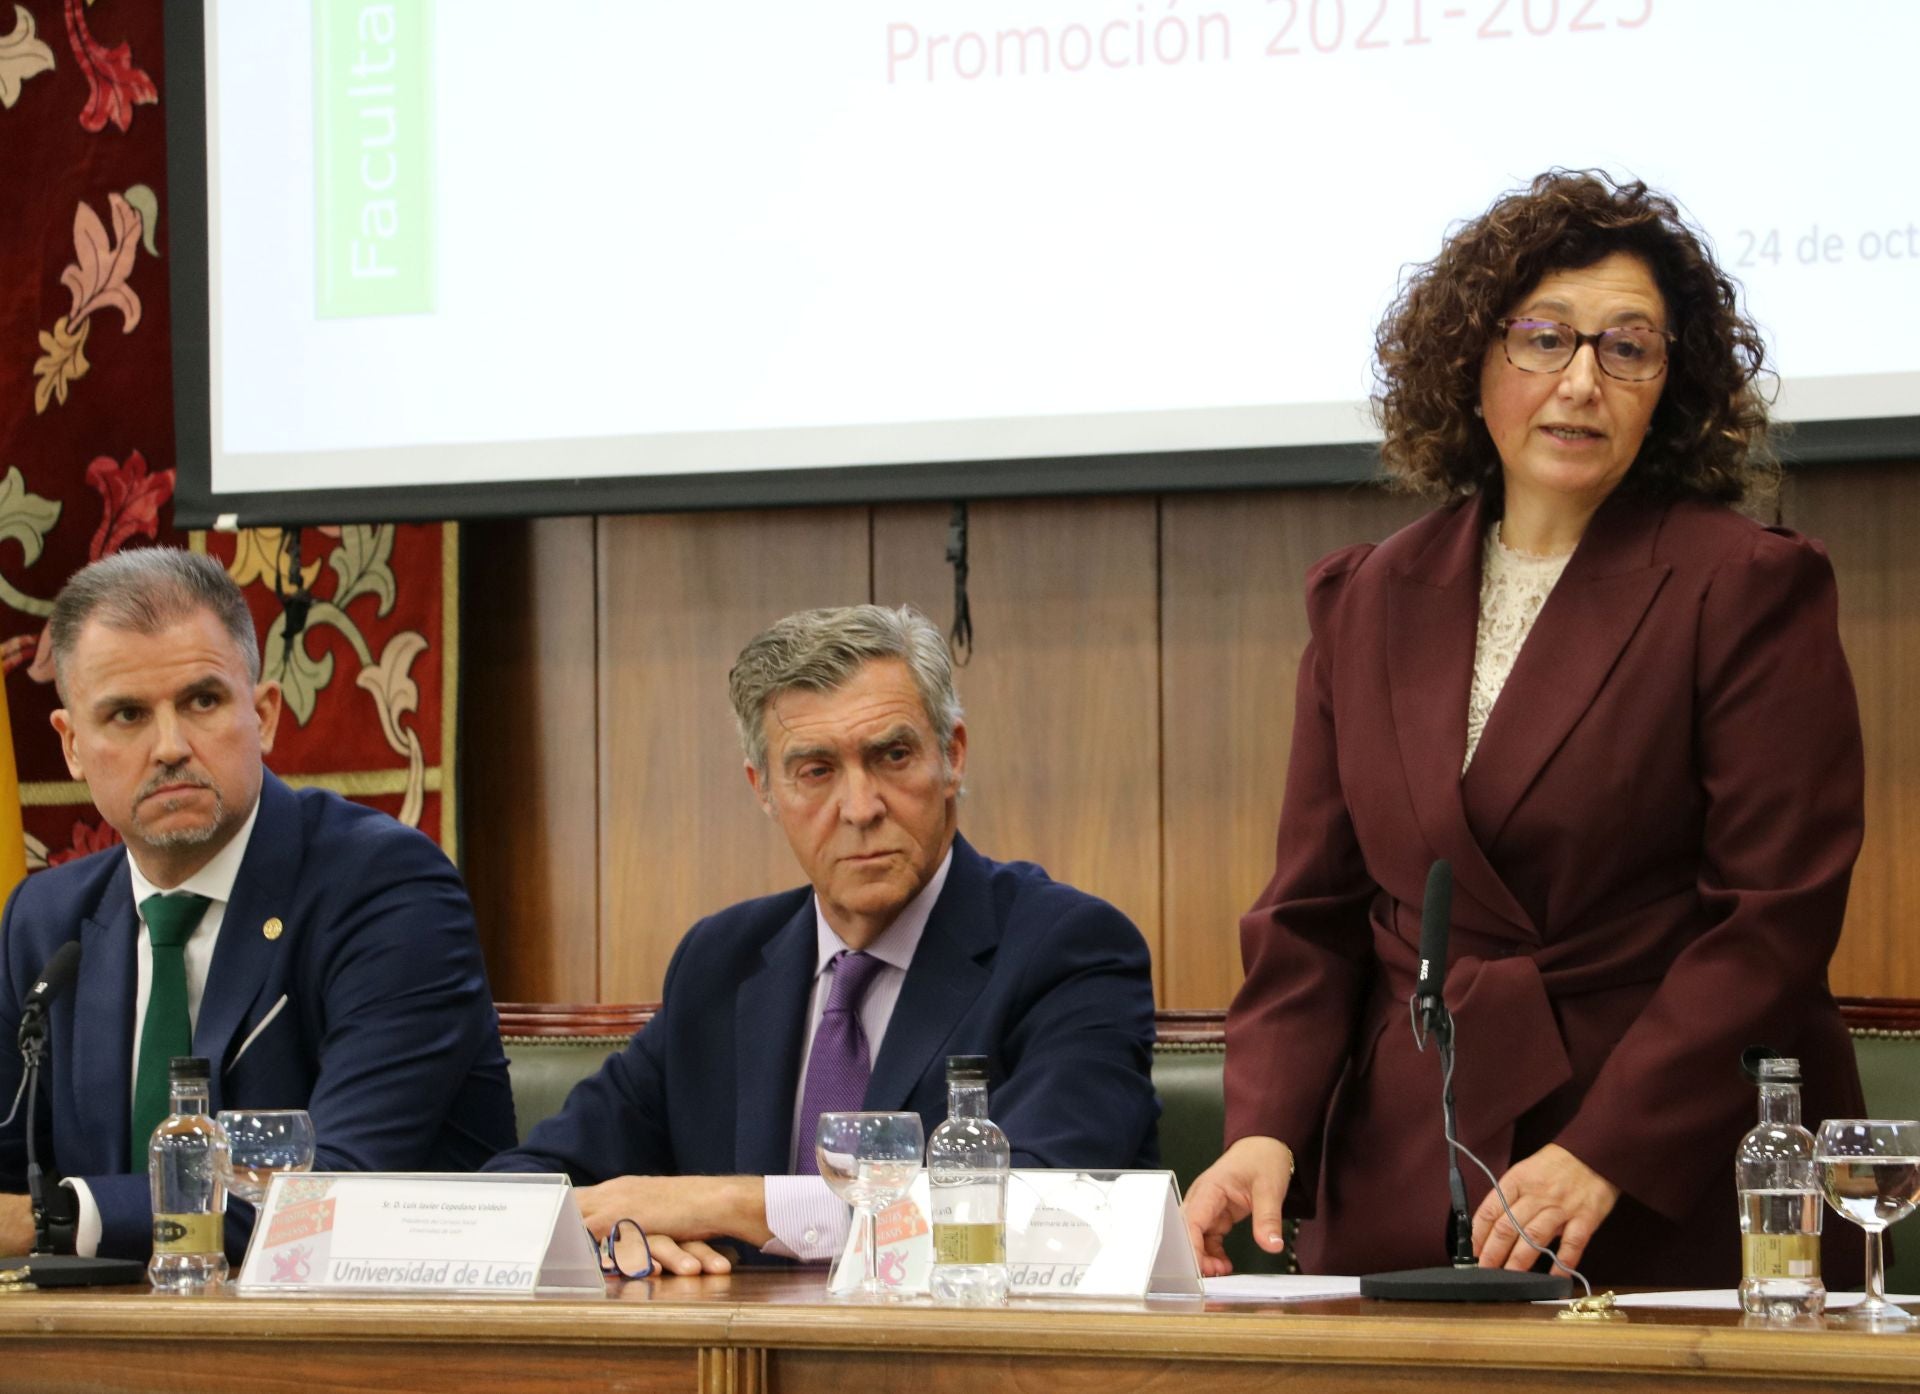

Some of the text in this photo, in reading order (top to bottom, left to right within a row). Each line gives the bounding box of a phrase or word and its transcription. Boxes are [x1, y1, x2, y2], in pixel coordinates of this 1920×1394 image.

[886, 0, 1231, 84] Promoción
[347, 2, 398, 279] Faculta
[1736, 222, 1920, 268] 24 de oct
[333, 1260, 533, 1287] Universidad de León
